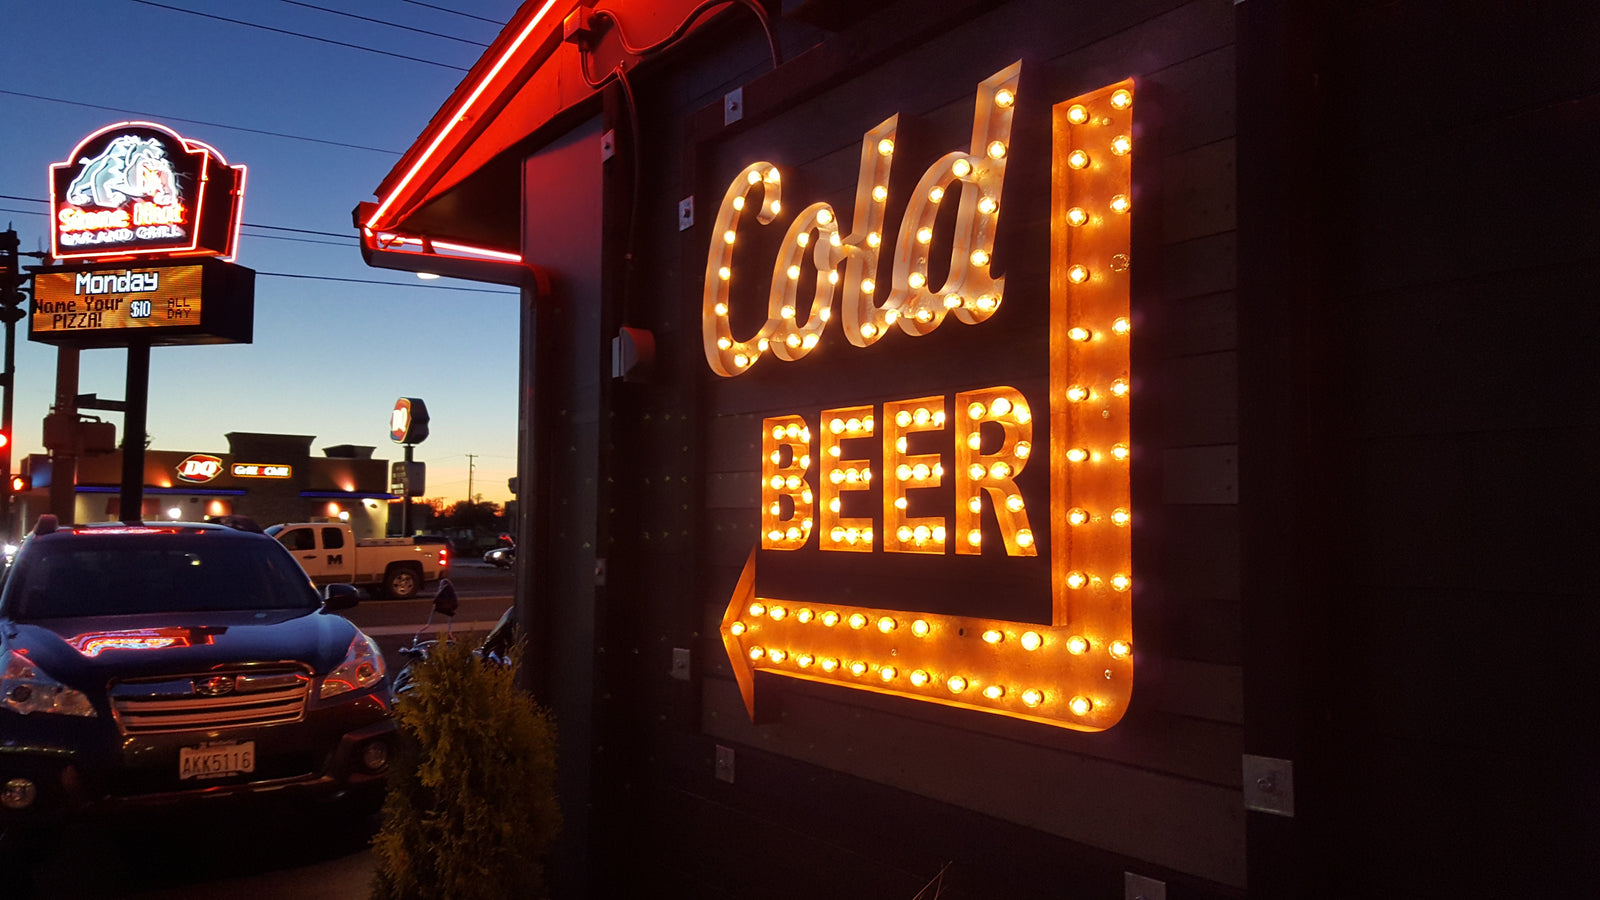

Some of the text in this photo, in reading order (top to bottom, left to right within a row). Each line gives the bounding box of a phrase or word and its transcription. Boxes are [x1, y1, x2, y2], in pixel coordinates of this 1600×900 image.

[703, 58, 1022, 377] Cold
[74, 270, 158, 295] Monday
[34, 296, 124, 314] Name Your
[130, 300, 152, 318] $10
[167, 297, 190, 308] ALL
[53, 312, 103, 329] PIZZA!
[167, 308, 191, 319] DAY
[183, 460, 217, 477] DQ
[761, 386, 1038, 557] BEER
[327, 554, 343, 565] M
[183, 751, 251, 776] AKK5116
